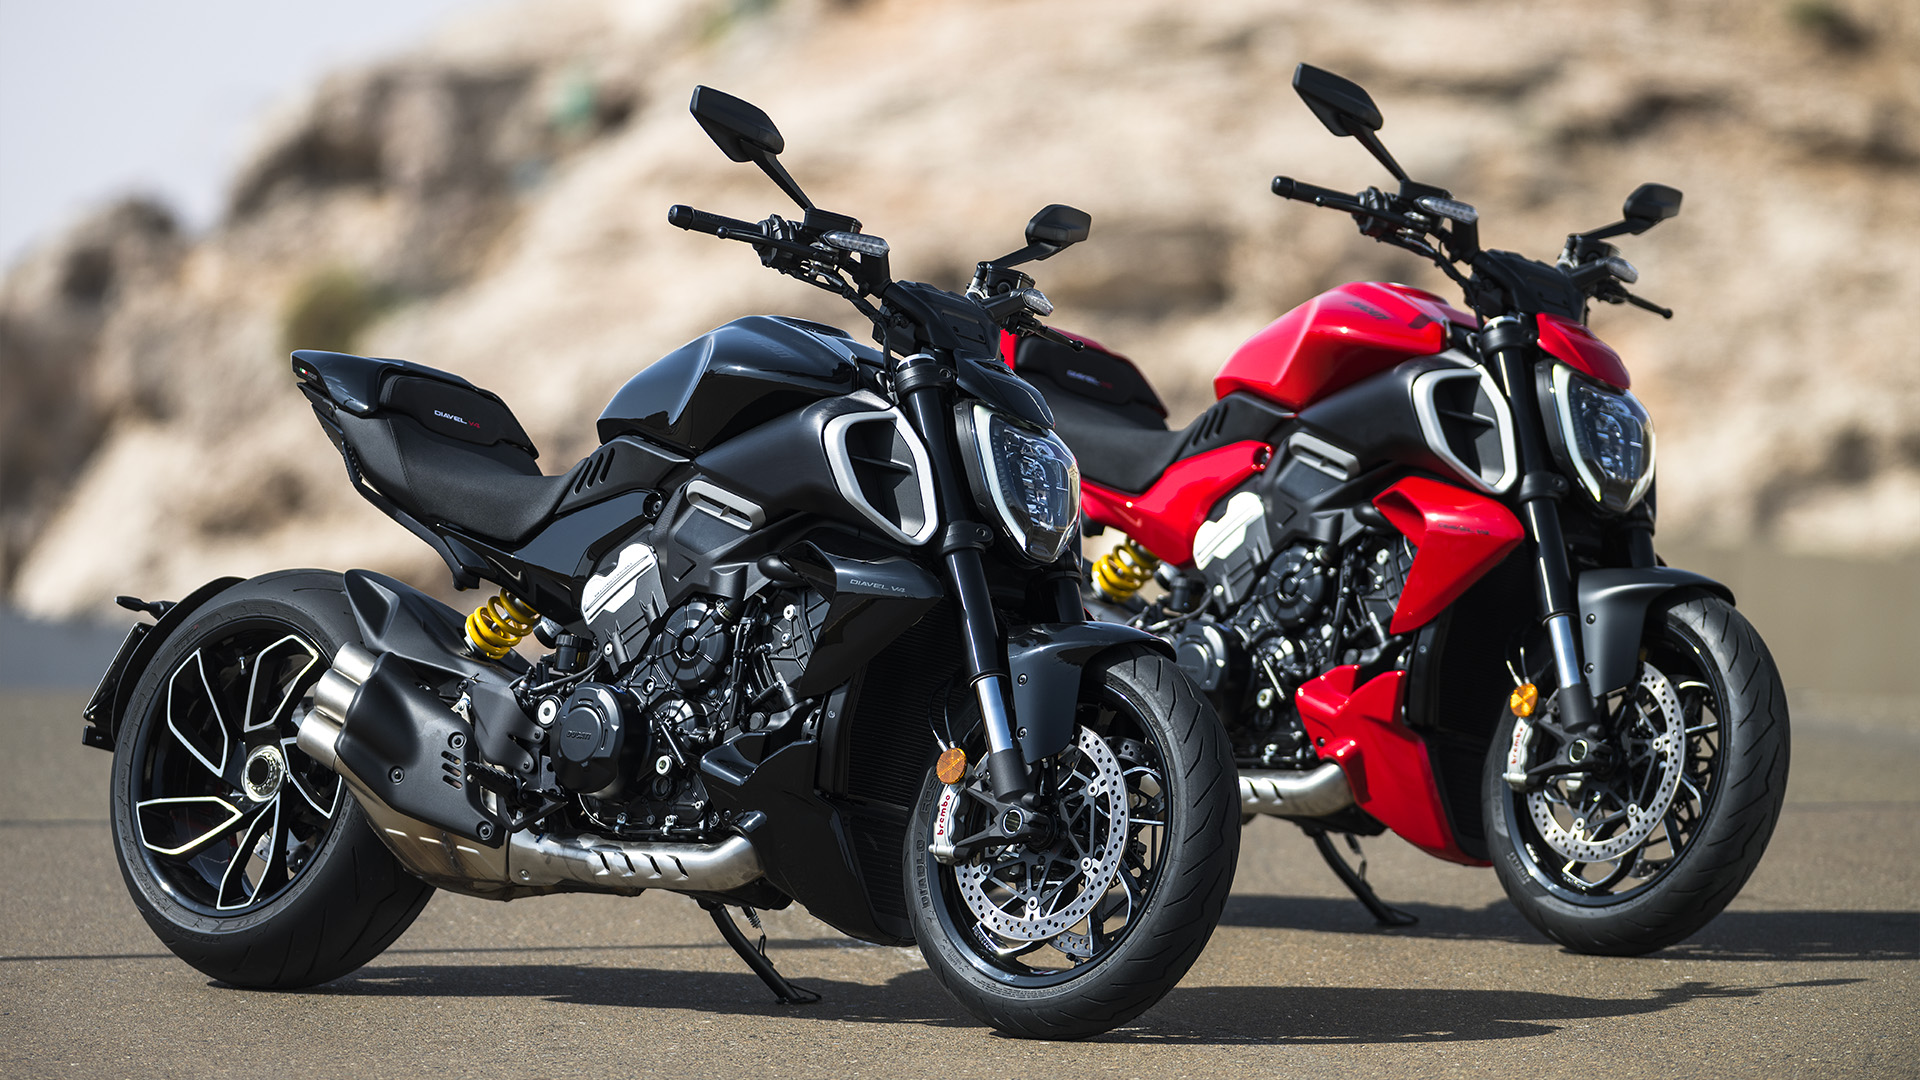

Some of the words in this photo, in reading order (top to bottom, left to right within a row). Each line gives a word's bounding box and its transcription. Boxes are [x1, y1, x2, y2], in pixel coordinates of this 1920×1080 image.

[434, 409, 468, 425] DIAVEL
[468, 420, 480, 429] V4
[849, 579, 889, 591] DIAVEL
[566, 729, 592, 741] DUCATI
[1511, 726, 1524, 765] brembo
[937, 794, 951, 836] brembo
[916, 839, 931, 909] DIABLO
